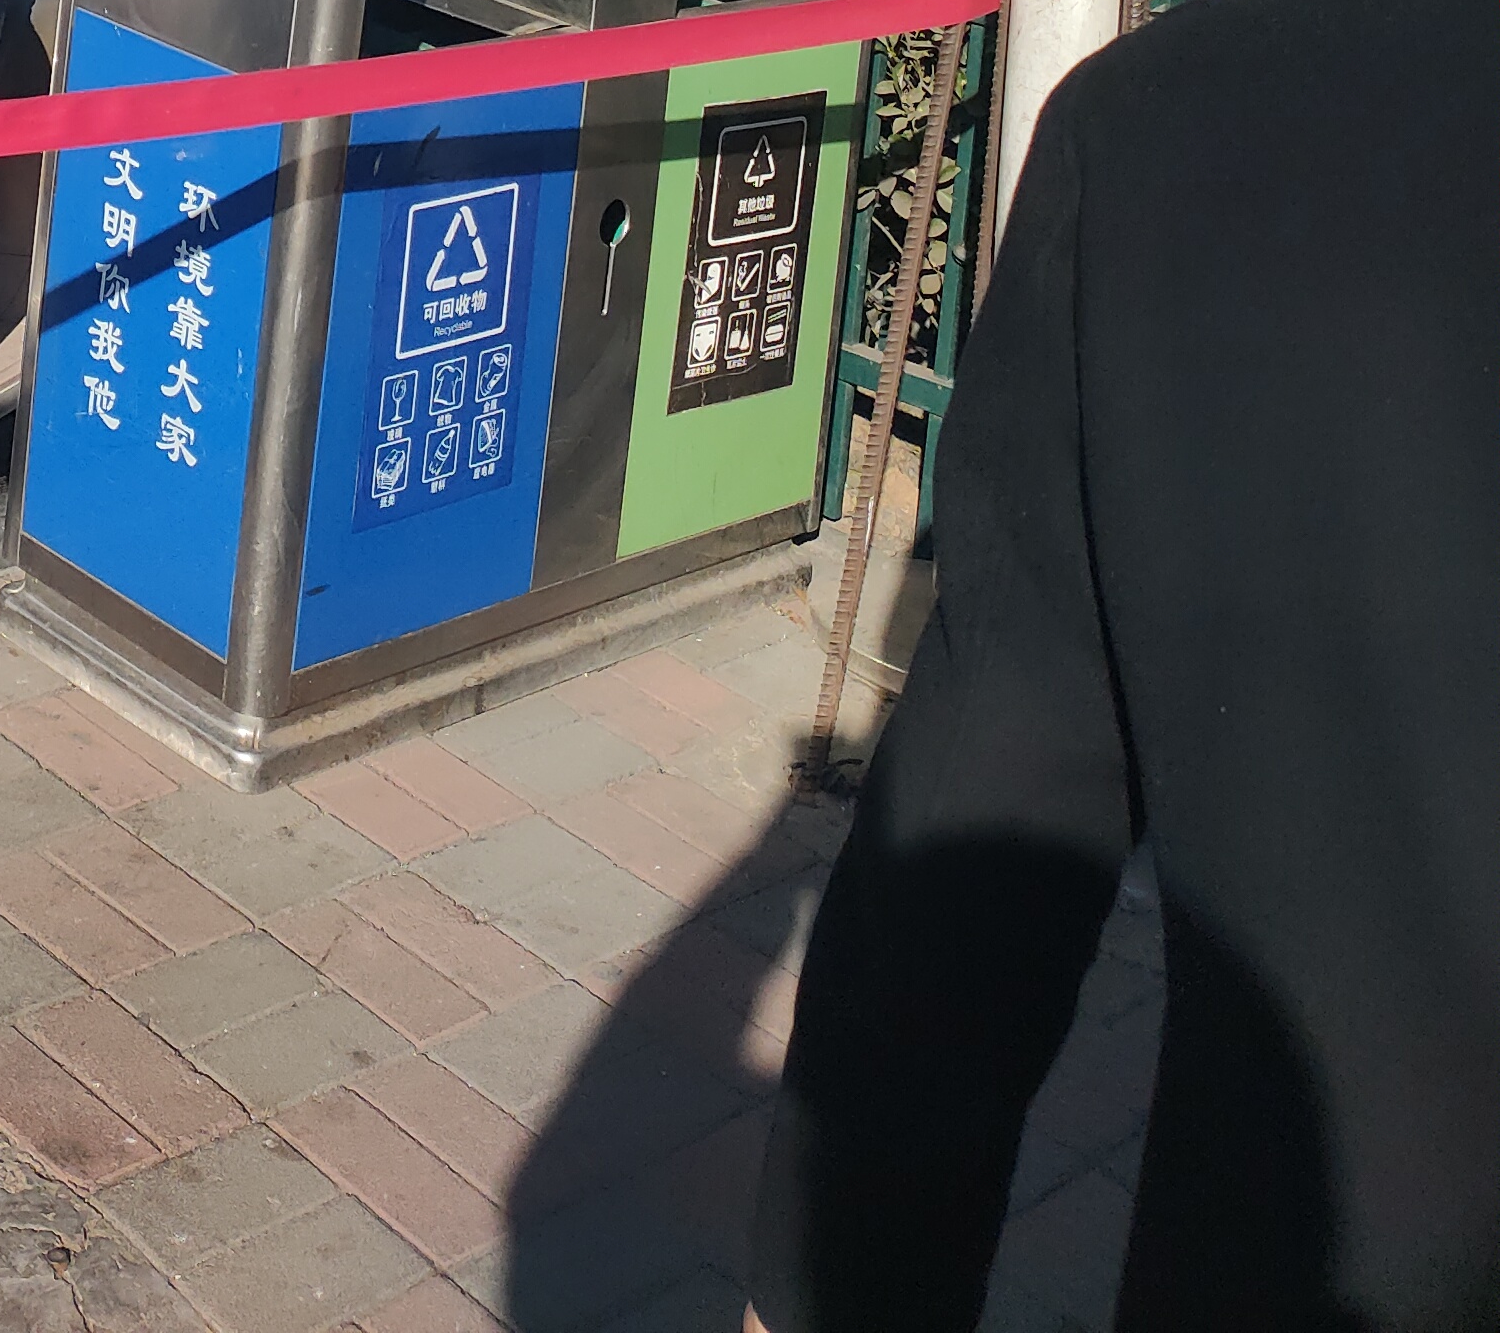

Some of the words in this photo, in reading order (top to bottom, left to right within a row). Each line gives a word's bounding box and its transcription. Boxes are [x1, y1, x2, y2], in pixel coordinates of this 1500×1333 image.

[83, 148, 143, 431] 文明你我他
[156, 181, 219, 467] 环境靠大家
[423, 289, 487, 324] 可回收物
[434, 320, 473, 338] Recyclable
